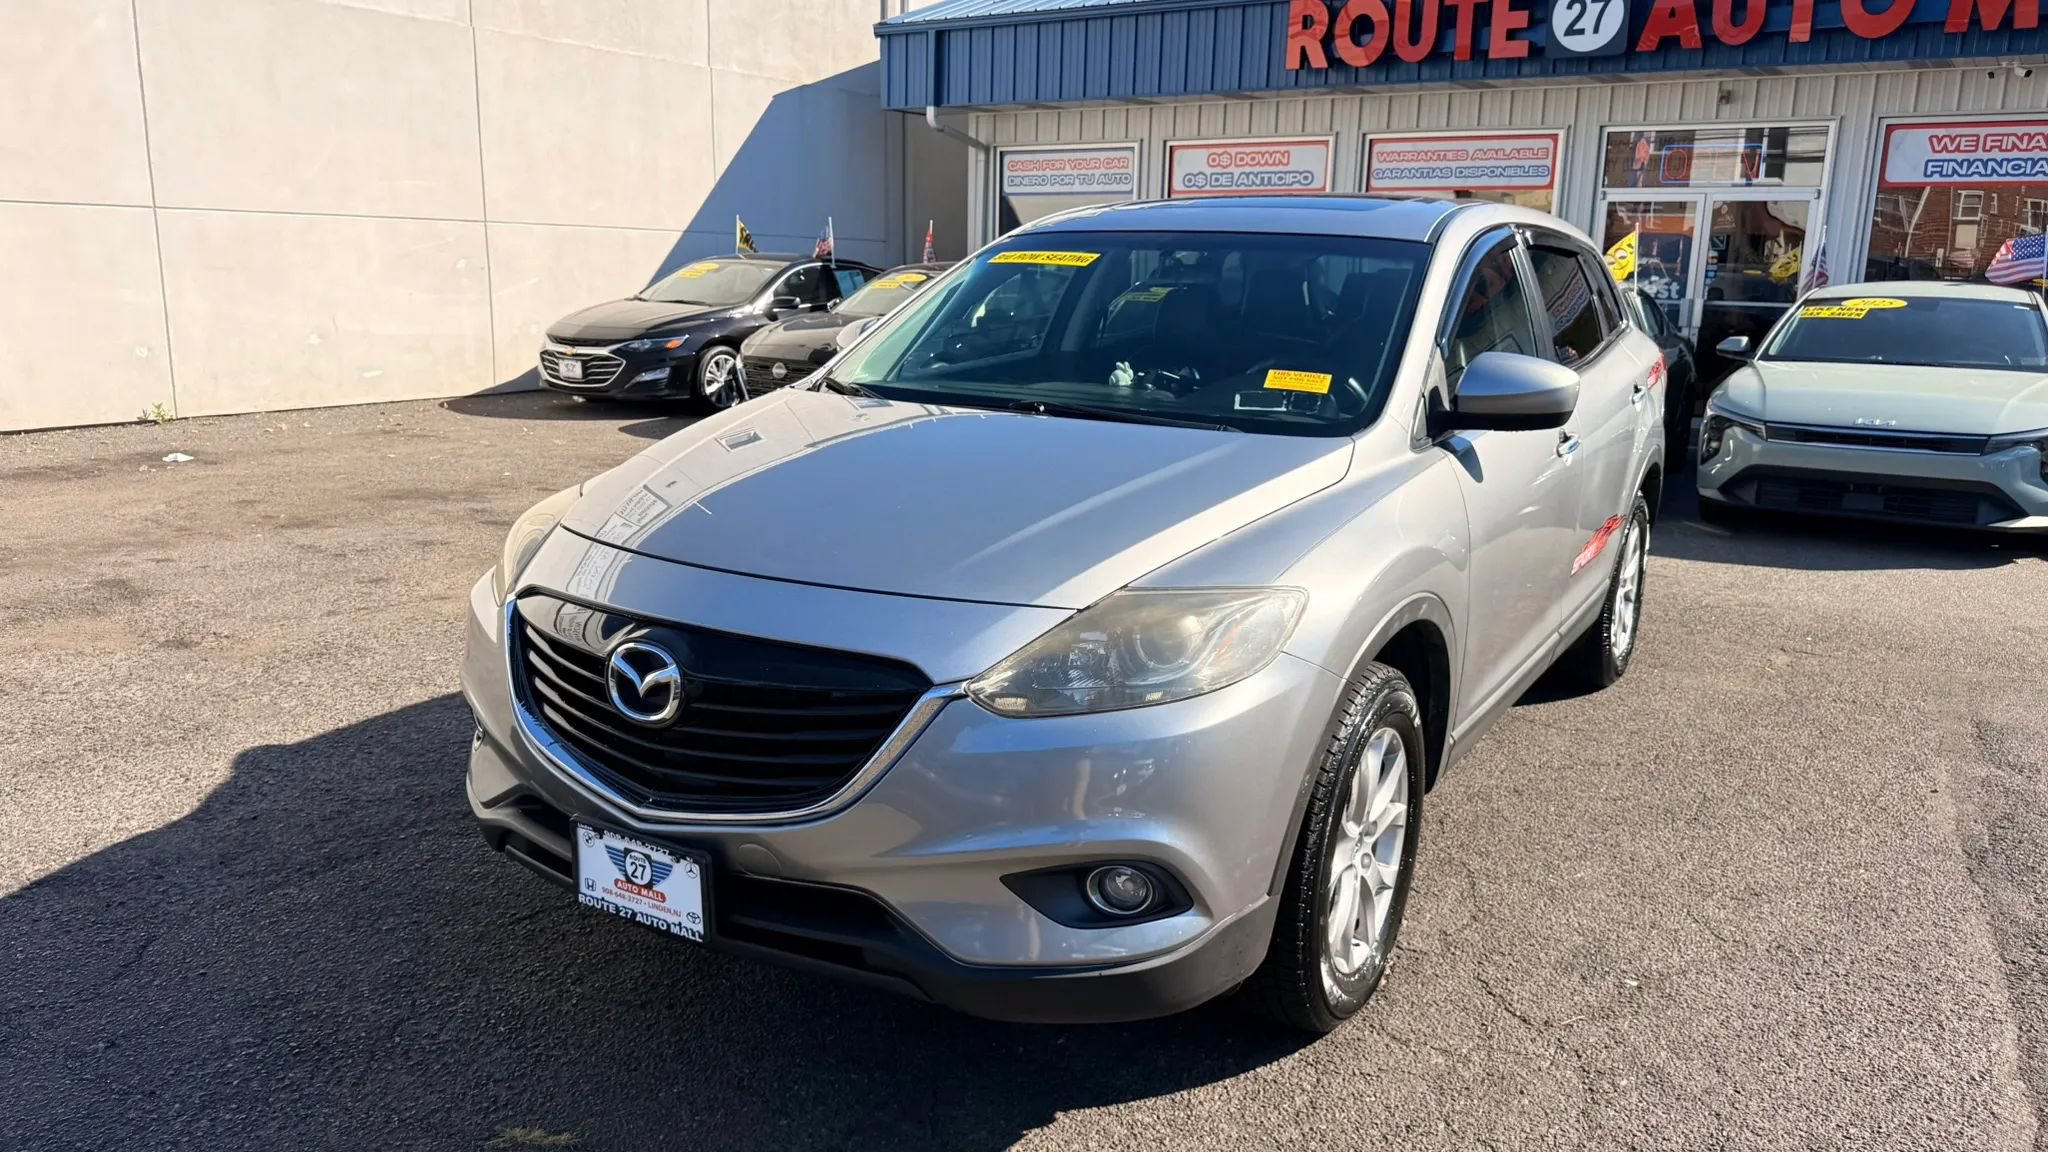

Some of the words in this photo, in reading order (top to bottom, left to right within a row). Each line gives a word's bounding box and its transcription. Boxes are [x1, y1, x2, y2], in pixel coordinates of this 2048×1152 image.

[1285, 0, 1531, 70] ROUTE
[1563, 0, 1609, 37] 27
[1928, 134, 1980, 153] WE
[1234, 150, 1290, 167] DOWN
[1376, 149, 1468, 163] WARRANTIES
[1470, 147, 1549, 161] AVAILABLE
[1007, 160, 1040, 172] CASH
[1042, 159, 1066, 171] FOR
[1067, 158, 1100, 170] YOUR
[1103, 157, 1129, 169] CAR
[1372, 167, 1452, 181] GARANTIAS
[1454, 165, 1550, 179] DISPONIBLES
[1923, 156, 2048, 178] FINANCIA
[1007, 174, 1048, 187] DINERO
[1050, 174, 1075, 186] POR
[1076, 173, 1095, 185] TU
[1096, 172, 1132, 185] AUTO
[1209, 171, 1234, 187] DE
[1235, 170, 1314, 187] ANTICIPO
[629, 854, 646, 864] ROUTE
[630, 861, 647, 881] 27
[617, 879, 639, 894] AUTO
[640, 886, 665, 902] MALL
[578, 893, 617, 914] ROUTE
[620, 905, 633, 919] 27
[635, 912, 667, 931] AUTO
[670, 922, 704, 943] MALL
